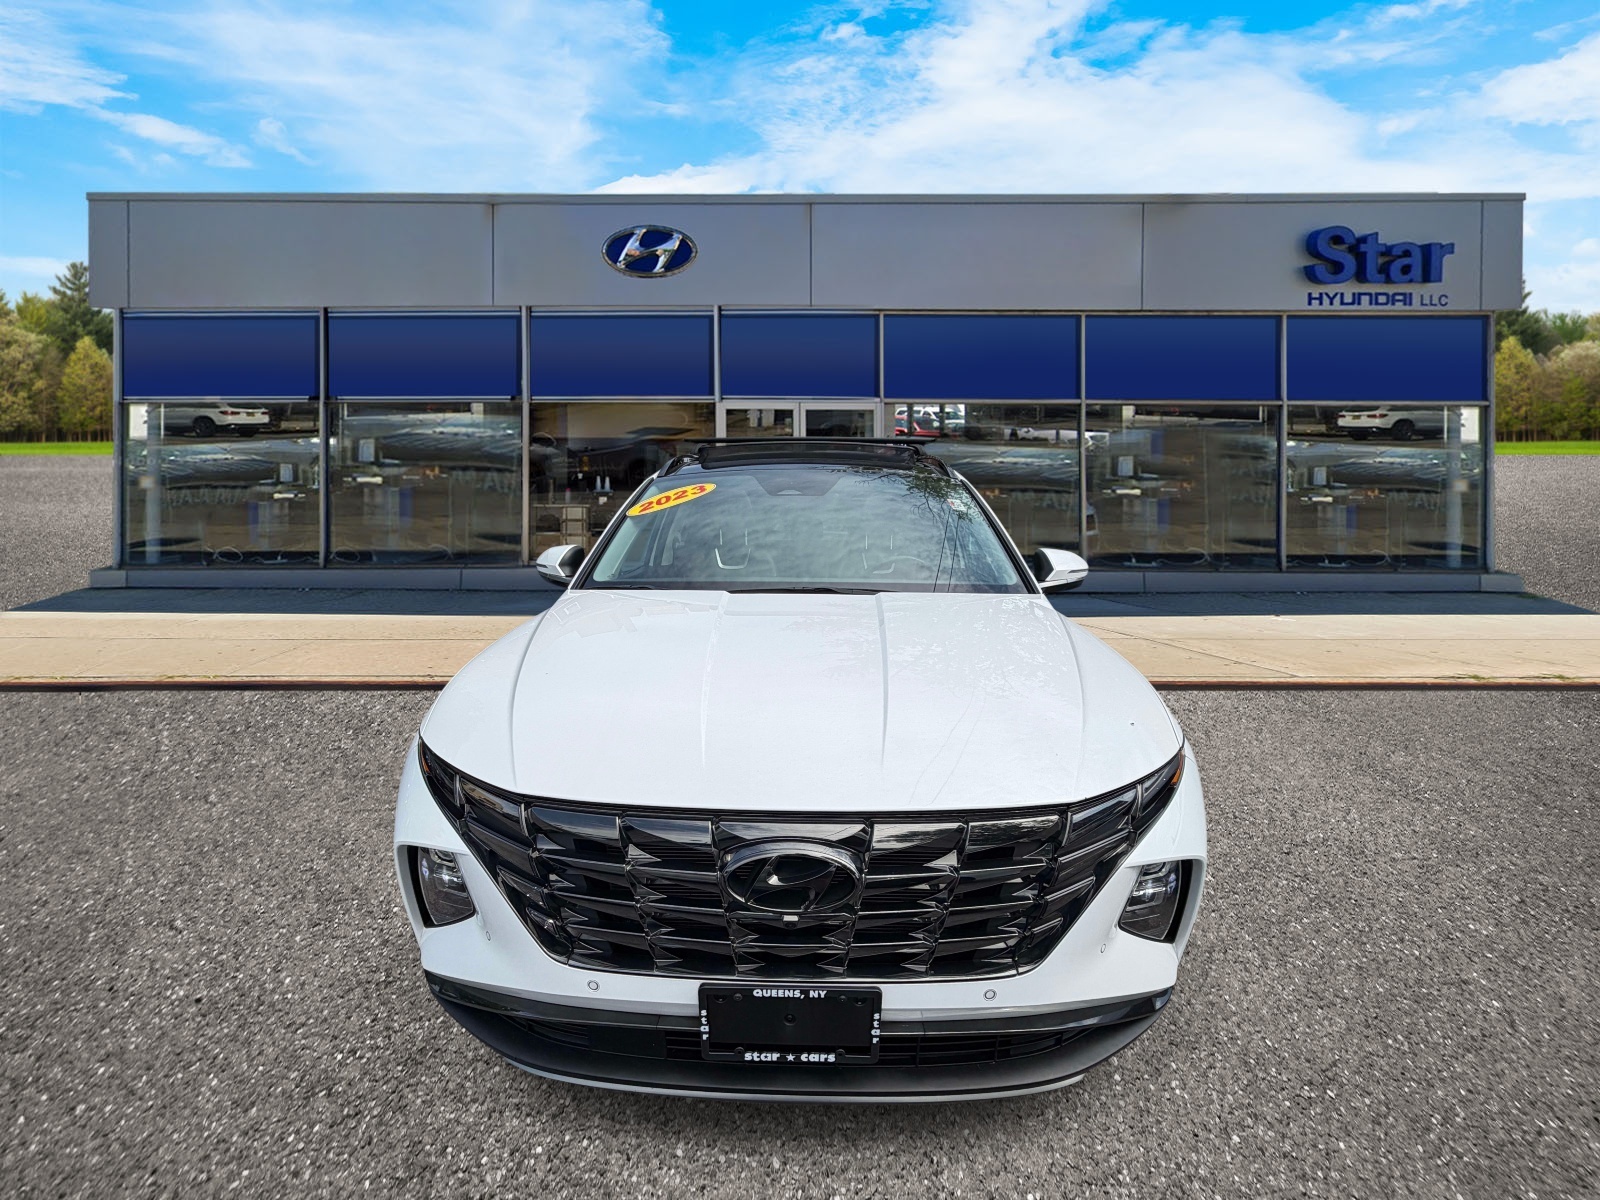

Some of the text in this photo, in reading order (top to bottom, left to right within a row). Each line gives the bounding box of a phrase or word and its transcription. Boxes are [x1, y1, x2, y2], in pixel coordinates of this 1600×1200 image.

[1303, 226, 1455, 284] Star
[1307, 292, 1449, 307] HYUNDAI LLC
[638, 485, 708, 513] 2023
[752, 988, 828, 999] QUEENS, NY
[700, 1009, 710, 1041] star
[871, 1013, 881, 1044] star
[744, 1051, 836, 1063] star cars
